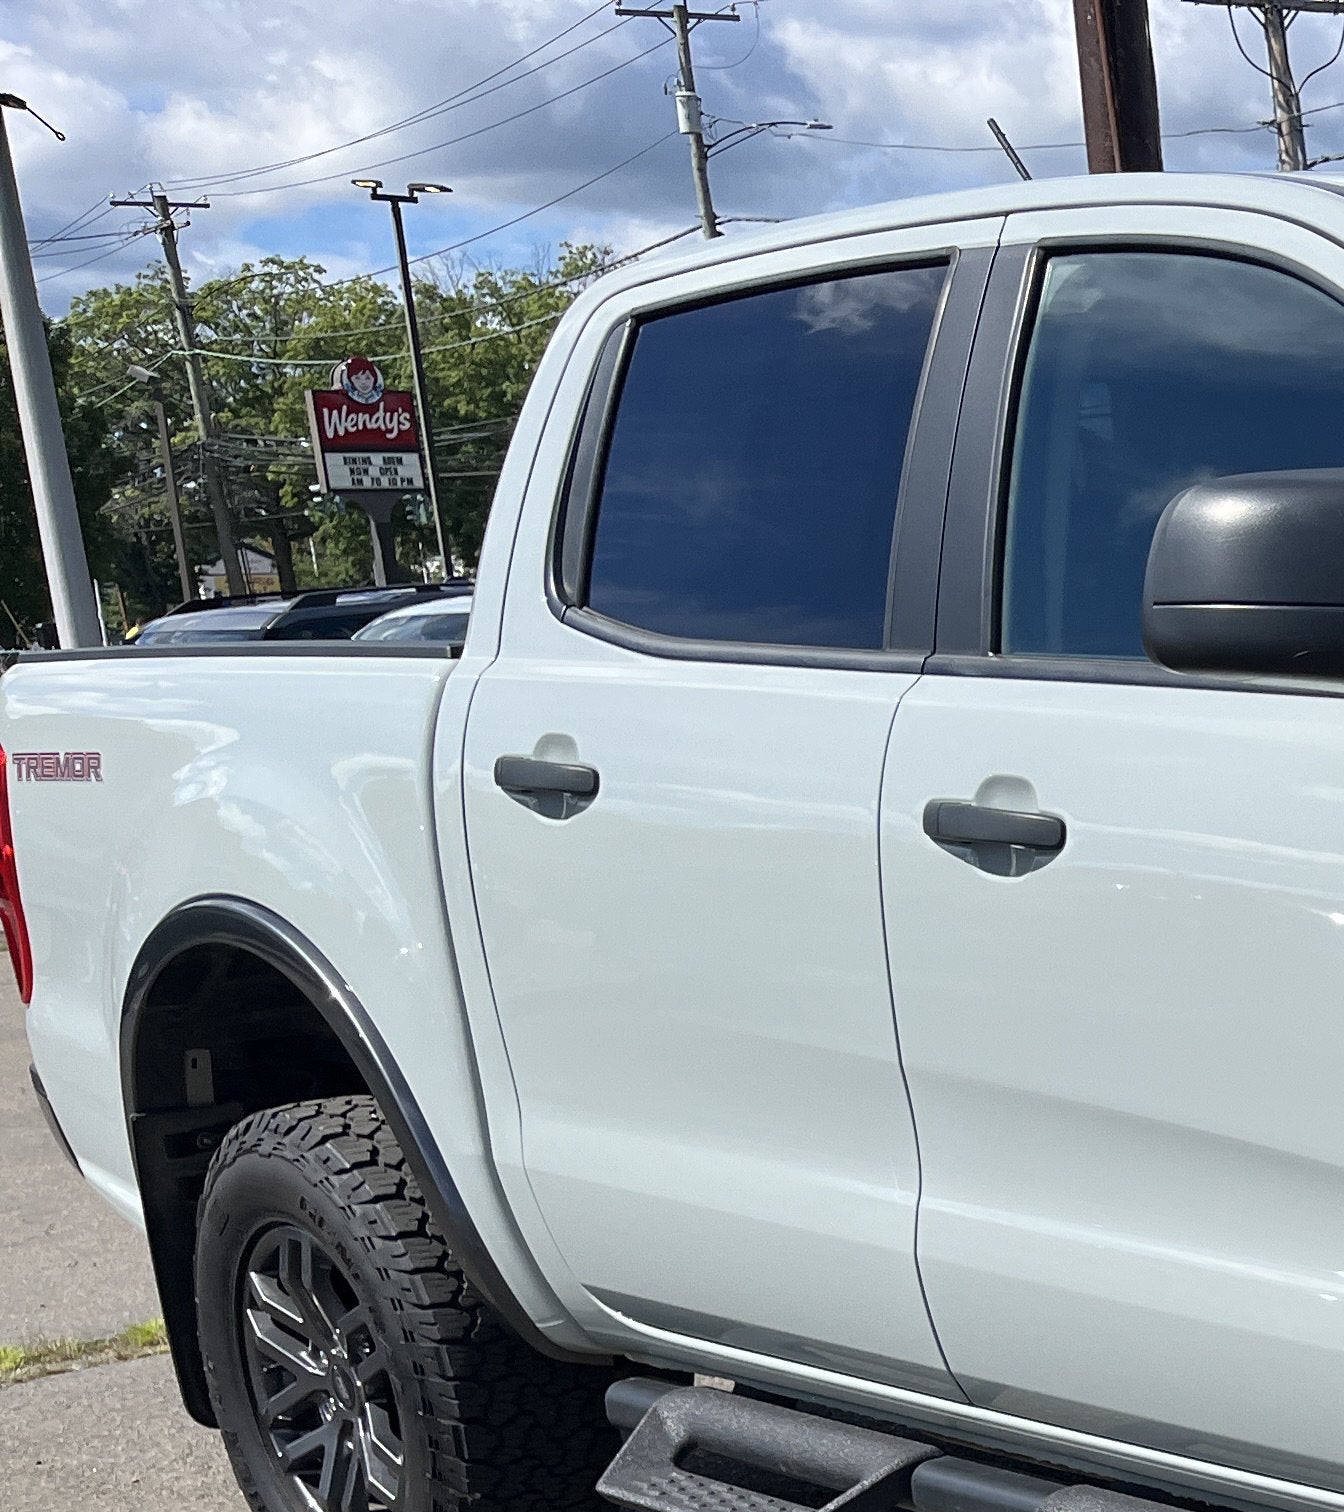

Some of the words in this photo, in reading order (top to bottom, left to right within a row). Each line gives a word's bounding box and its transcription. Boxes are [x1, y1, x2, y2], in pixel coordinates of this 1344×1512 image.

[323, 402, 411, 439] Wendy's
[349, 467, 369, 476] NOW
[12, 752, 103, 782] TREMOR
